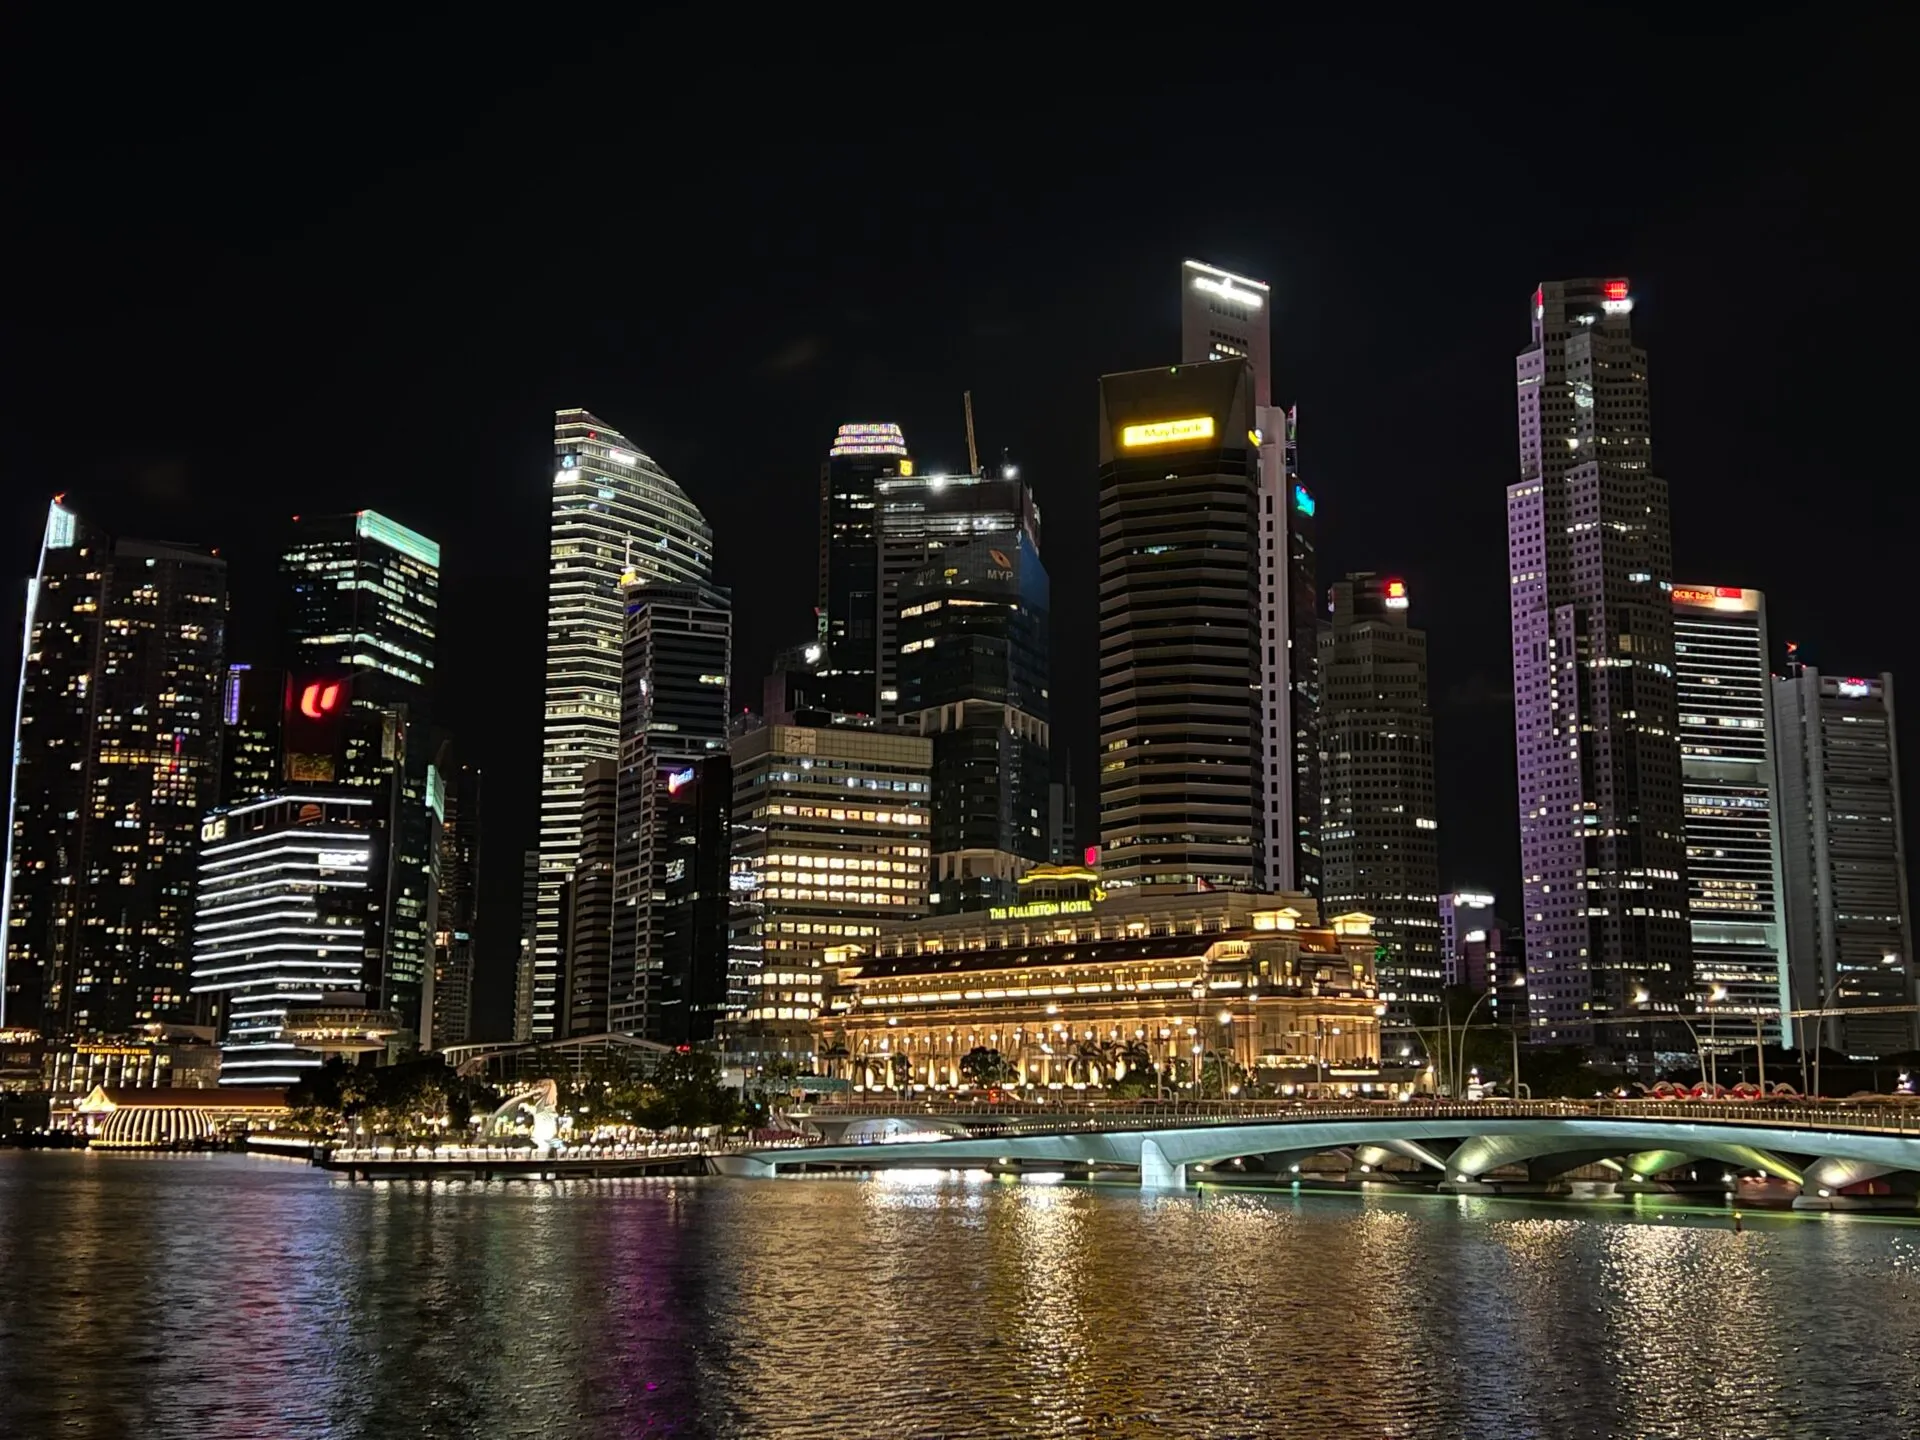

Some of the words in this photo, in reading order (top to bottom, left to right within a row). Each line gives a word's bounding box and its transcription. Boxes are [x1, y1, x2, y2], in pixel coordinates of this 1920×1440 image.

[987, 569, 1014, 581] MYP
[1673, 590, 1695, 600] OCBC
[201, 818, 227, 842] OUE
[989, 908, 1007, 920] THE
[1008, 903, 1059, 918] FULLERTON
[1061, 901, 1092, 914] HOTEL
